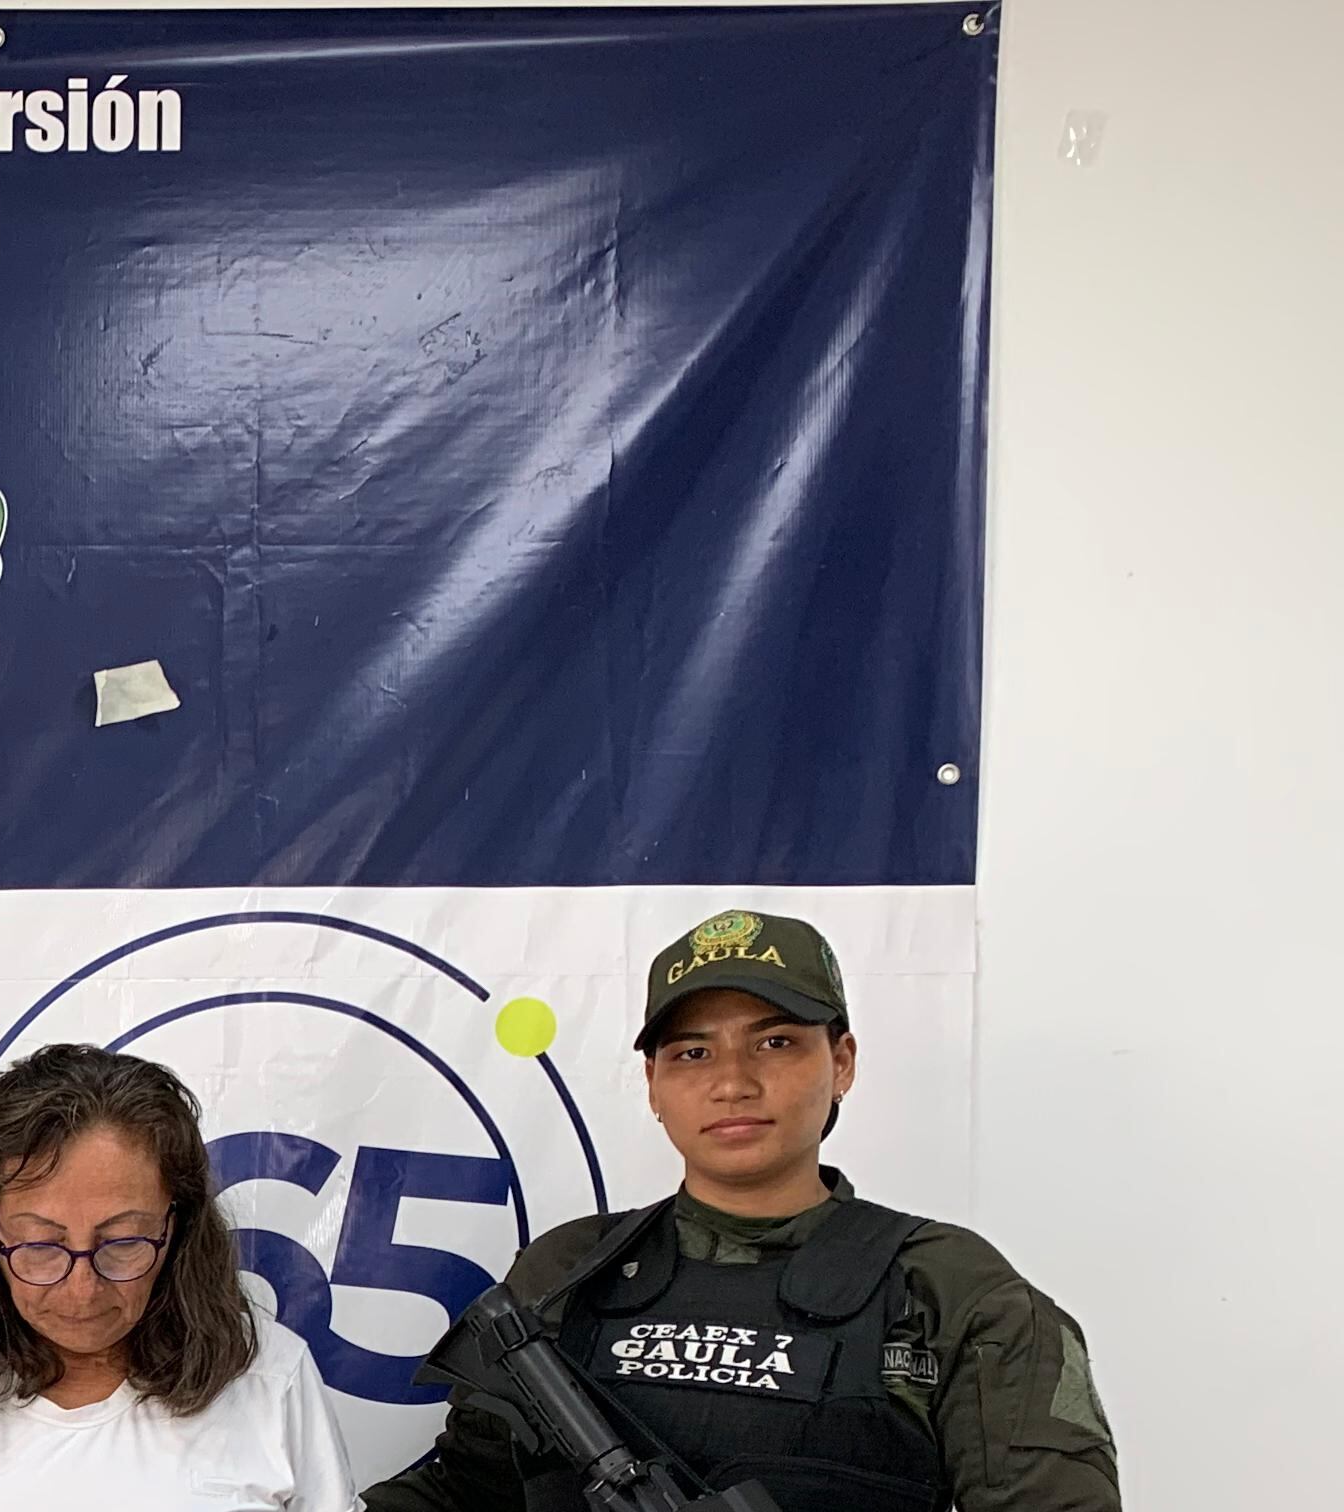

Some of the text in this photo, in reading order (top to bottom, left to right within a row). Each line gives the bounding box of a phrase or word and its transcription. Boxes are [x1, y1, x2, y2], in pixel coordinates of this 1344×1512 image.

[667, 945, 787, 985] GAULA
[629, 1323, 794, 1349] CEAEX 7
[611, 1338, 796, 1375] GAULA
[615, 1359, 781, 1391] POLICIA
